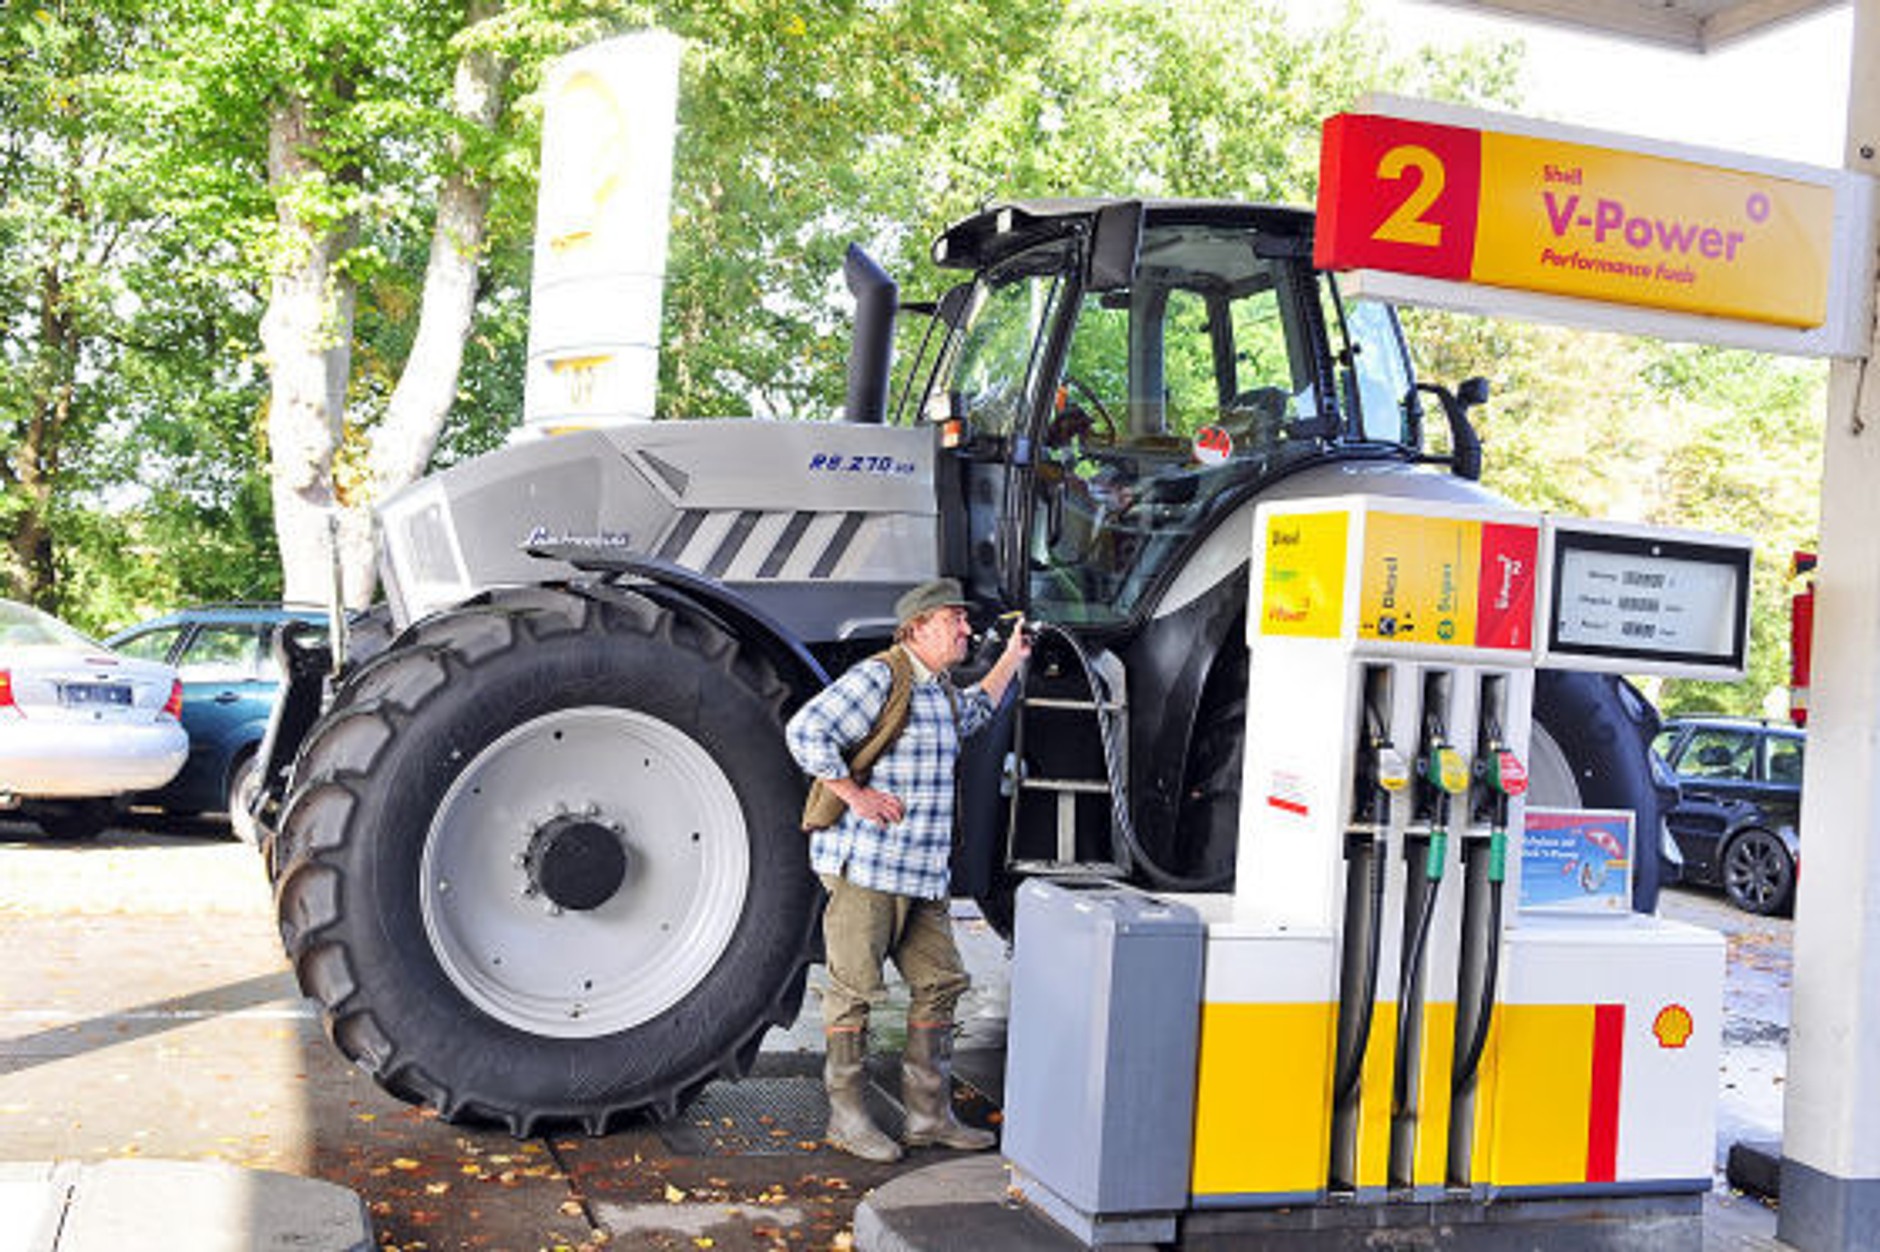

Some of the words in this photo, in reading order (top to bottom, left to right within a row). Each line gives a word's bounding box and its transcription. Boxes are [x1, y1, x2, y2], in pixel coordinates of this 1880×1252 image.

[1371, 145, 1445, 246] 2
[1543, 165, 1582, 185] Shell
[1543, 191, 1744, 262] V-Power
[1541, 248, 1652, 278] Performance
